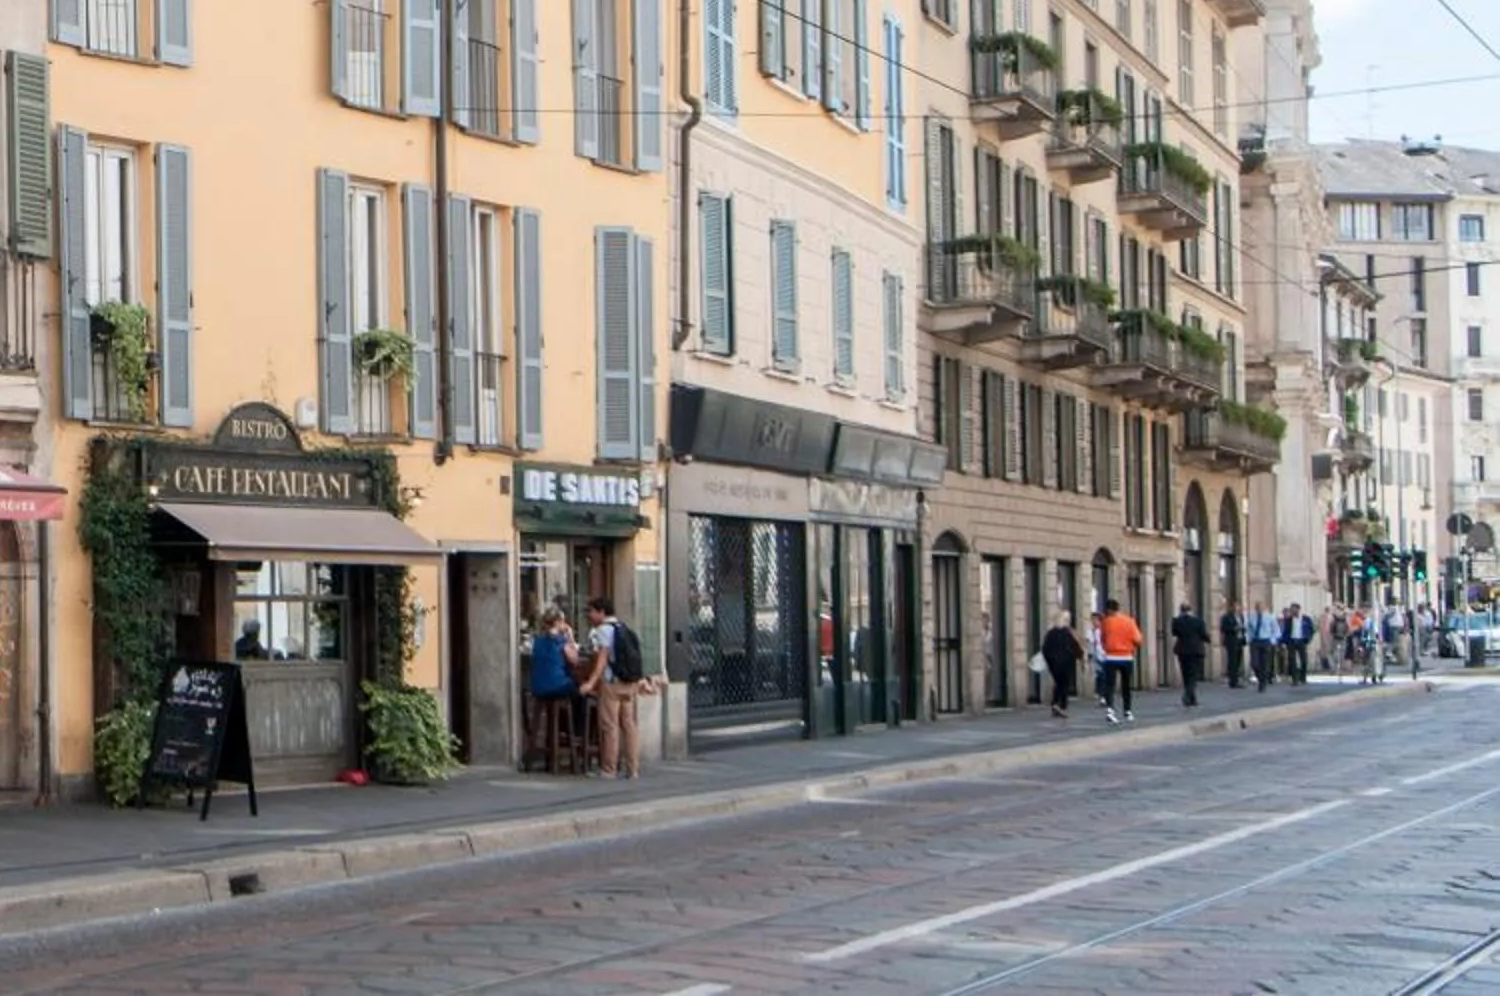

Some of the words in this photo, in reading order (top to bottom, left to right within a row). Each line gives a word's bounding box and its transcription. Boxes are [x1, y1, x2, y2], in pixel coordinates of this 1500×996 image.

[232, 468, 352, 499] RESTAURANT
[523, 469, 557, 501] DE
[561, 472, 640, 507] SANTIS
